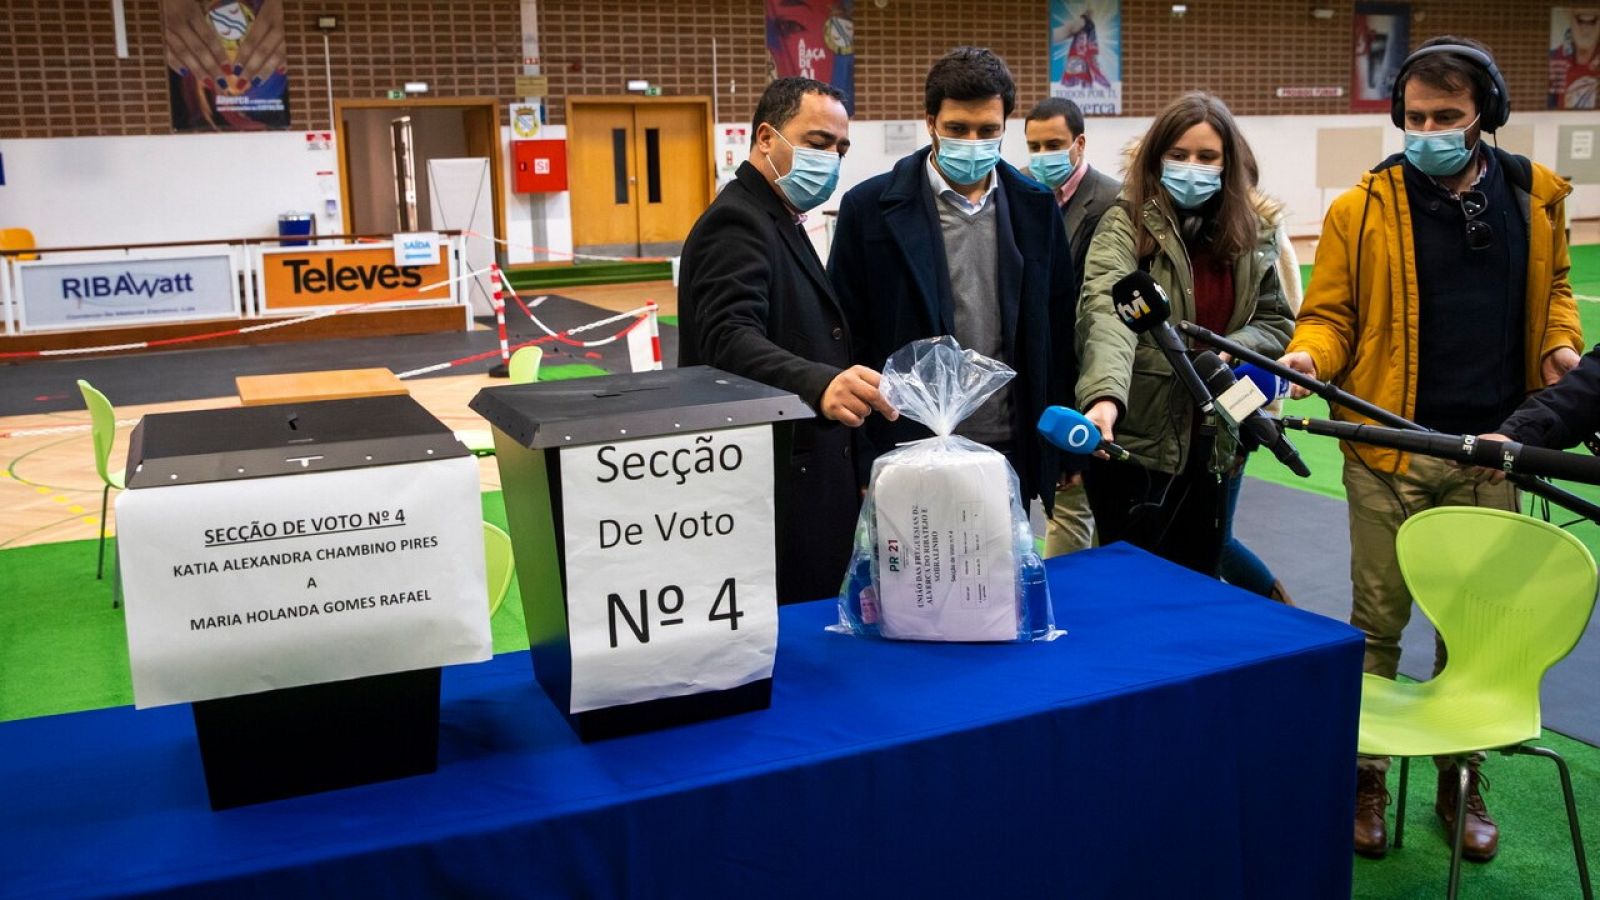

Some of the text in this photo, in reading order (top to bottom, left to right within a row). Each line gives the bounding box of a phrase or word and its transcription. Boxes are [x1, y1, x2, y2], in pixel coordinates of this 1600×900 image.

[1116, 289, 1151, 323] tvi
[596, 435, 743, 485] Secção
[204, 509, 406, 545] SECÇÃO DE VOTO Nº 4
[599, 510, 735, 549] De Voto
[887, 539, 899, 552] 21
[173, 535, 439, 577] KATIA ALEXANDRA CHAMBINO PIRES
[307, 577, 317, 589] A
[190, 590, 432, 631] MARIA HOLANDA GOMES RAFAEL
[607, 577, 744, 648] Nº 4
